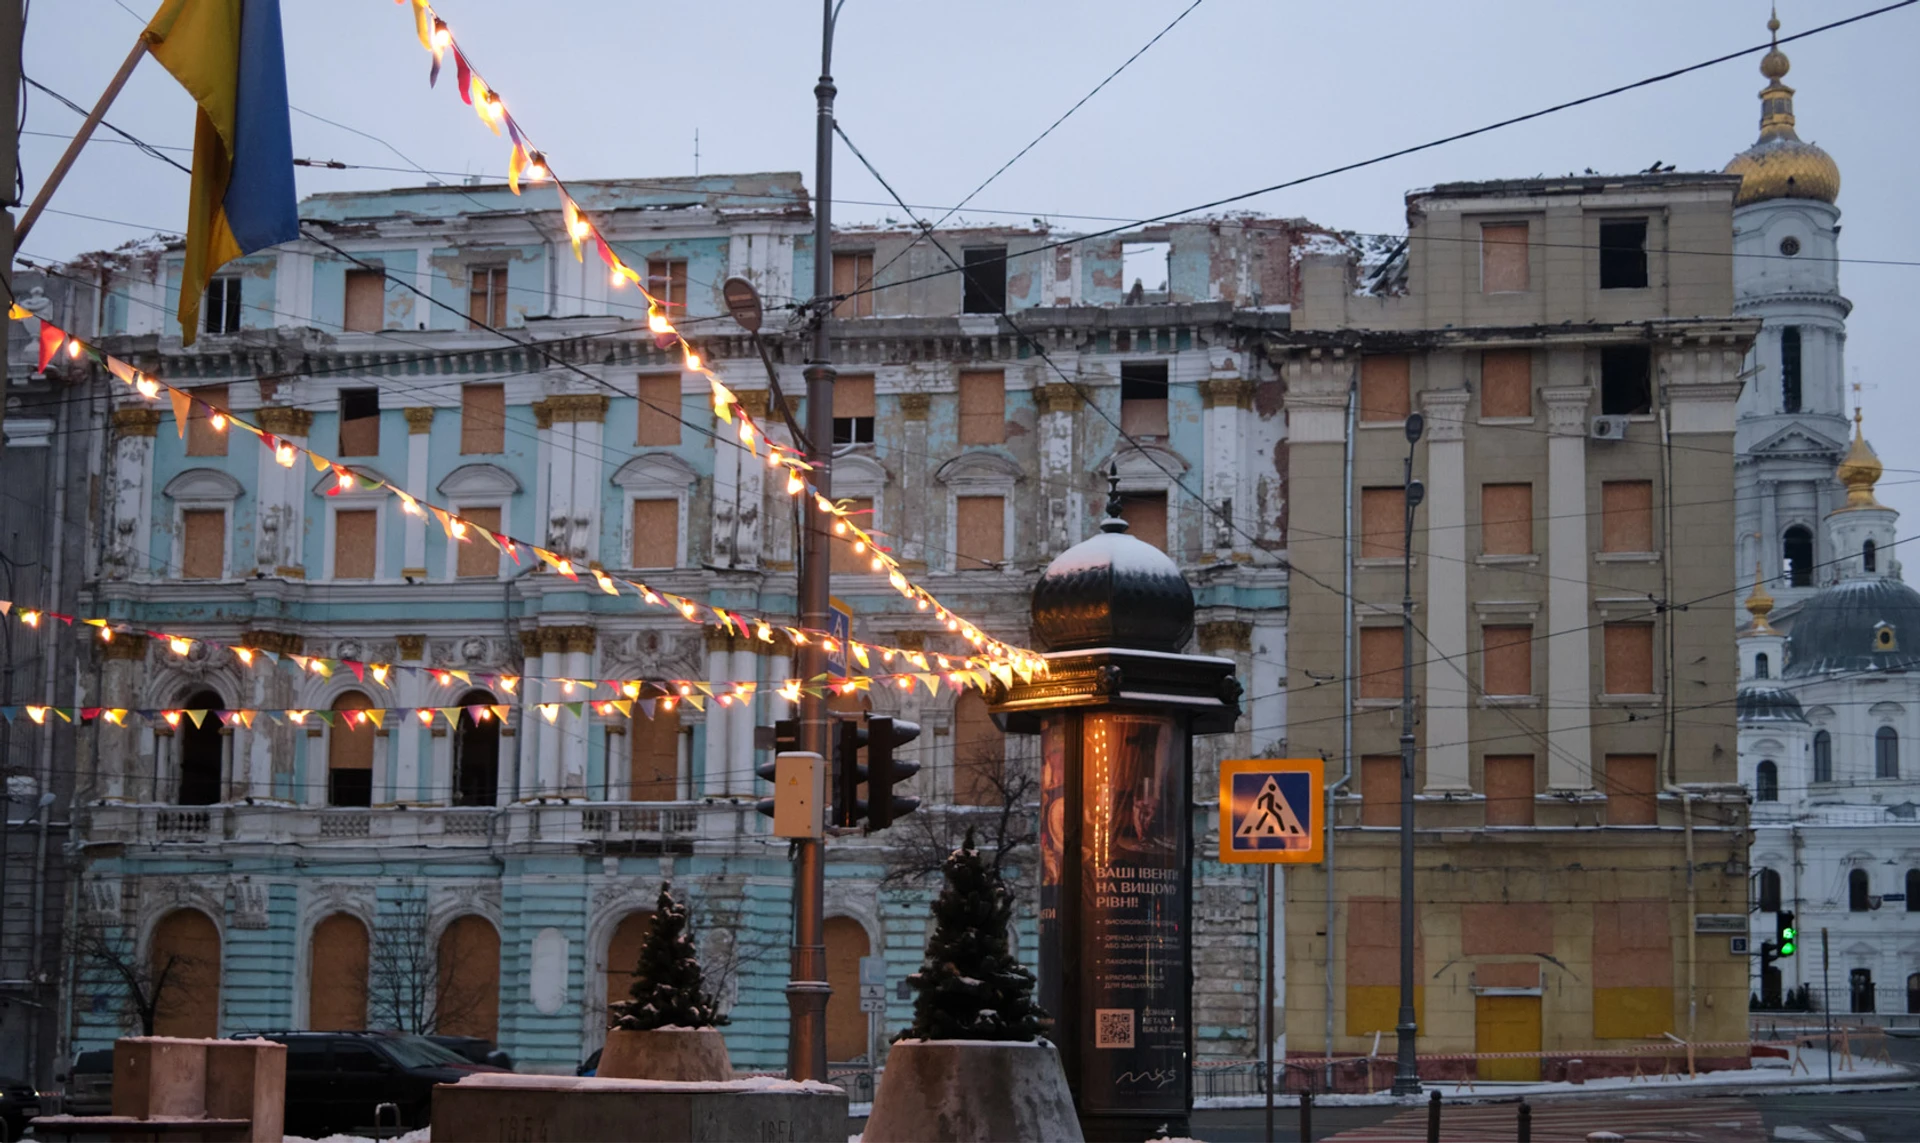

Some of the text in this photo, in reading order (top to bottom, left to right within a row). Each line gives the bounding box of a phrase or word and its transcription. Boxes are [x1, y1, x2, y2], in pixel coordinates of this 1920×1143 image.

[1096, 867, 1135, 879] ВАШІ
[1095, 882, 1176, 896] НА ВИЩОМУ
[1095, 896, 1139, 908] РІВНІ!
